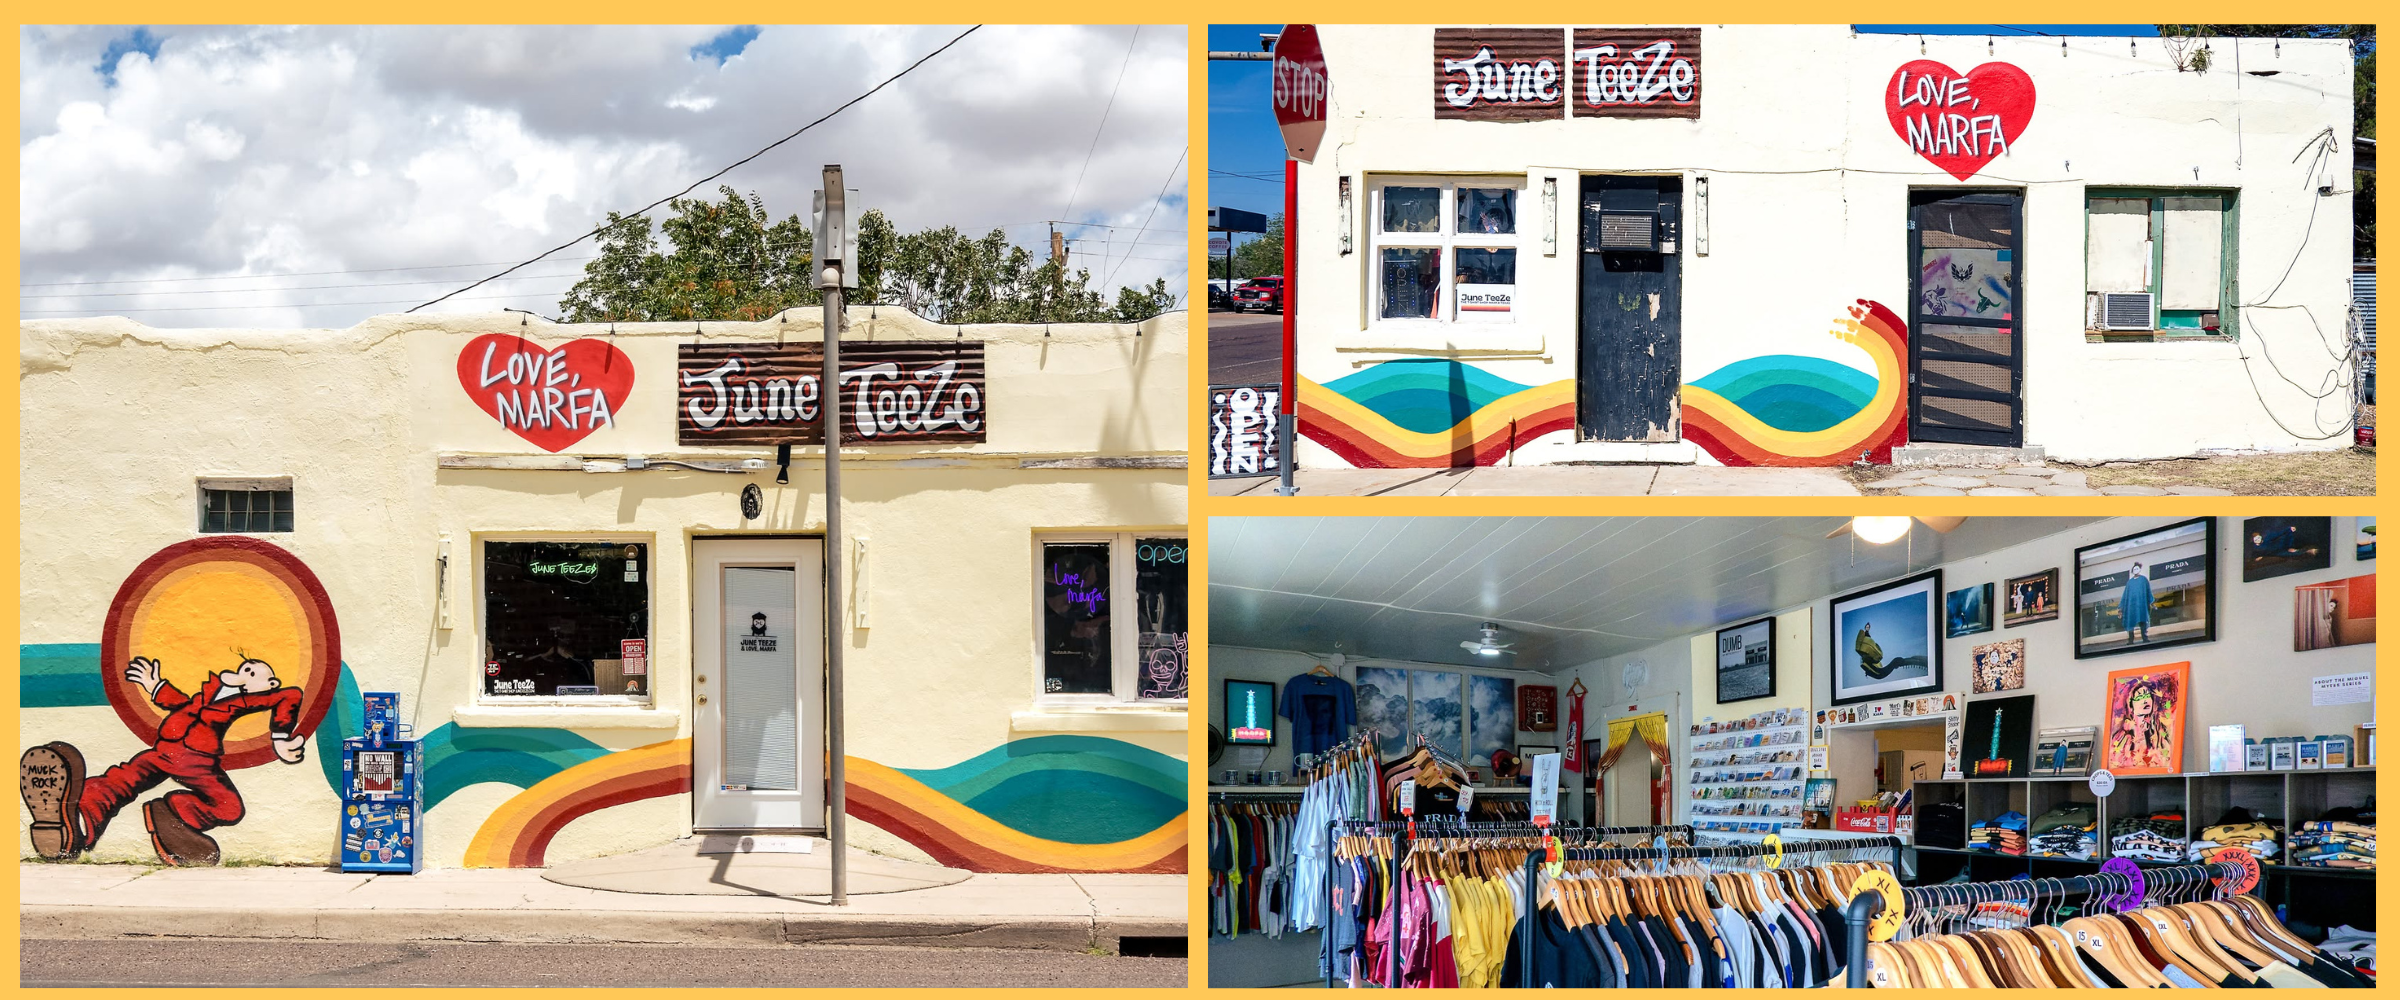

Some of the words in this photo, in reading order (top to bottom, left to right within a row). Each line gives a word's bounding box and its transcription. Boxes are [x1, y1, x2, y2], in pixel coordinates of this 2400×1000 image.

[1444, 46, 1561, 107] June
[1575, 41, 1698, 105] TeeZe
[1276, 56, 1325, 120] STOP
[1898, 70, 1979, 111] LOVE,
[1906, 112, 2009, 156] MARFA
[1461, 293, 1483, 301] June
[1485, 294, 1511, 302] TeeZe
[480, 341, 580, 388] LOVE,
[683, 358, 822, 429] June
[839, 360, 982, 438] TeeZe
[496, 387, 614, 430] MARFA
[529, 562, 557, 574] JUNE
[2165, 560, 2189, 570] PRADA
[2094, 576, 2115, 586] PRADA
[758, 639, 777, 647] TEEZE
[1722, 634, 1742, 653] DUMB
[494, 679, 512, 690] June
[513, 679, 536, 690] TeeZe
[28, 765, 58, 775] MUCK
[32, 776, 57, 789] ROCK
[2222, 851, 2245, 862] XXXL
[1877, 876, 1891, 895] XL
[1885, 908, 1899, 927] XL
[2092, 939, 2102, 947] XL
[1876, 972, 1887, 982] XL
